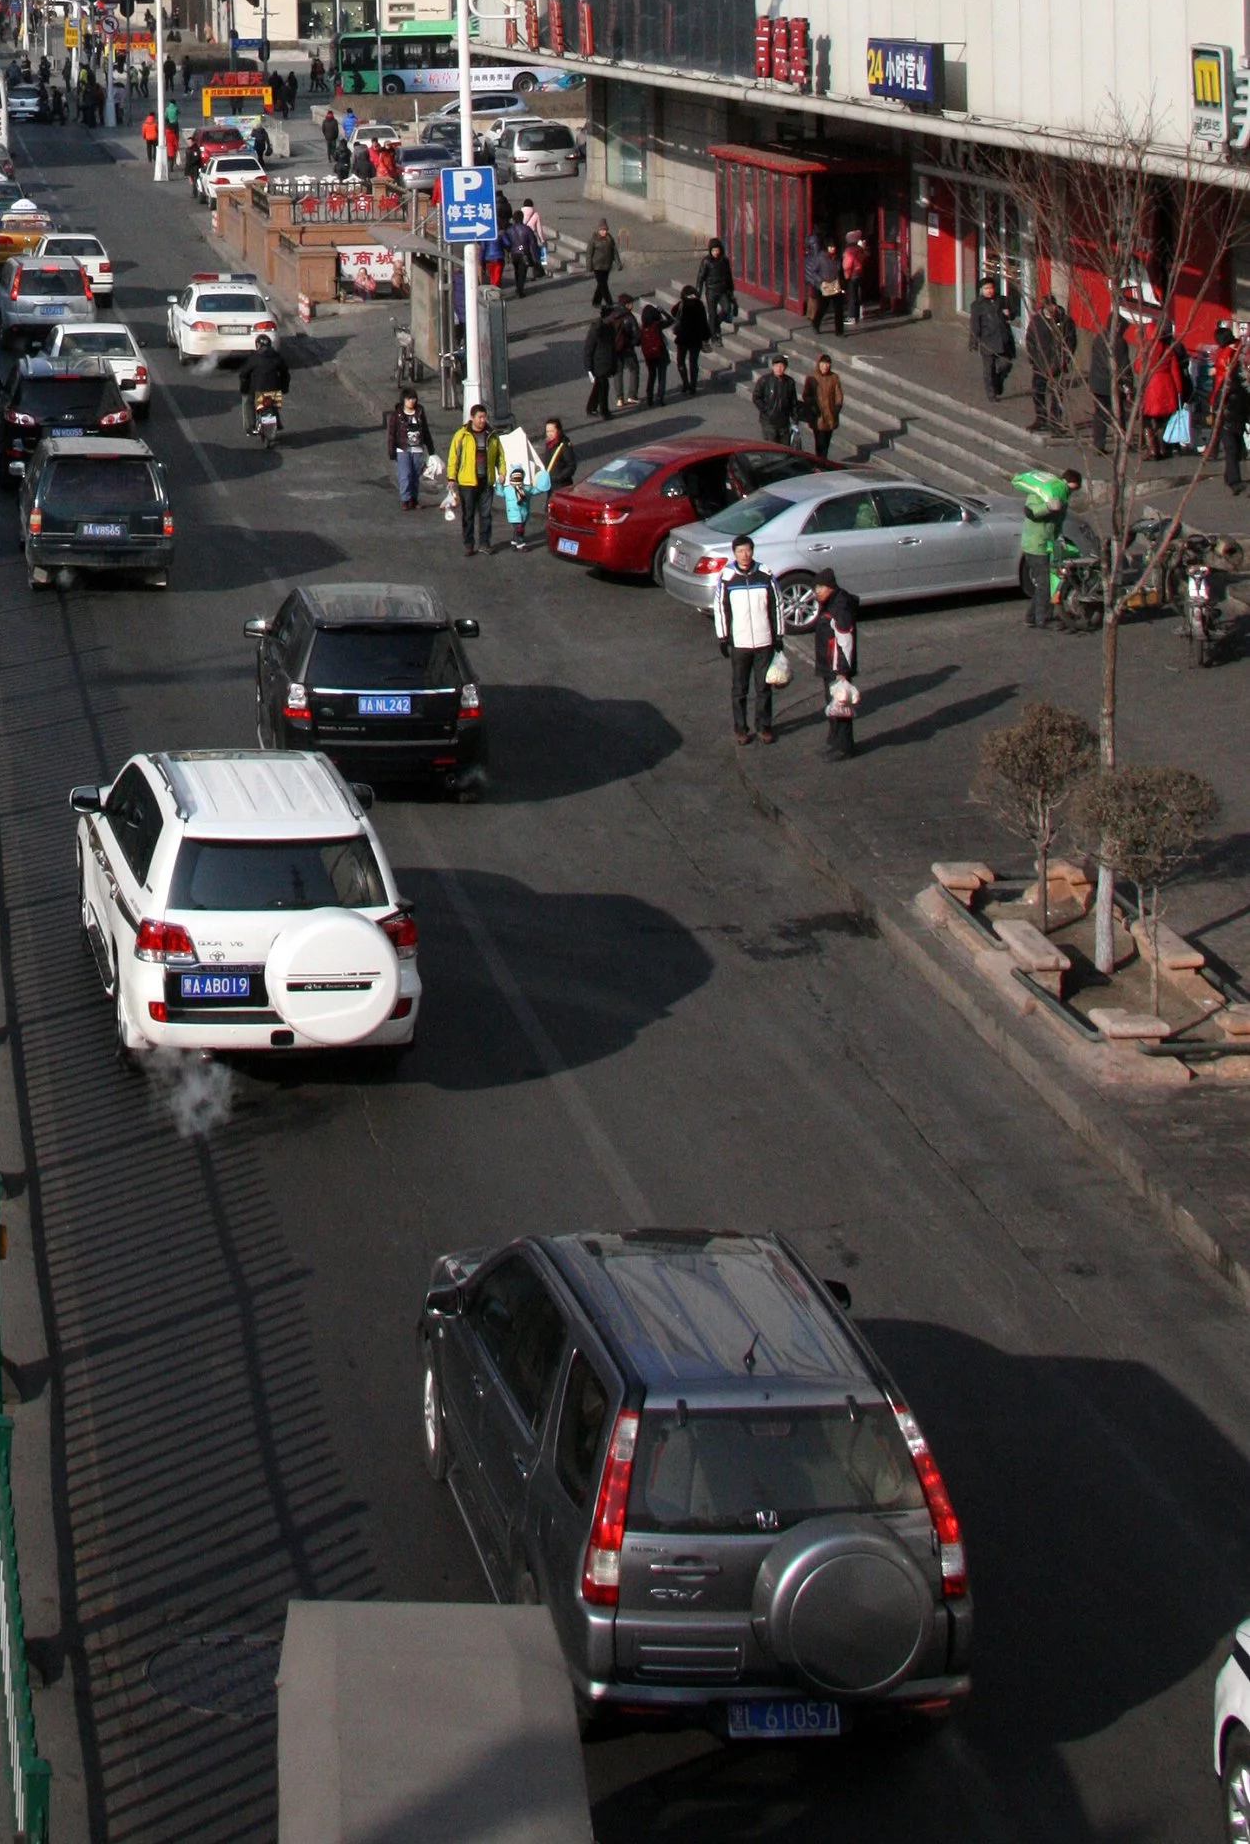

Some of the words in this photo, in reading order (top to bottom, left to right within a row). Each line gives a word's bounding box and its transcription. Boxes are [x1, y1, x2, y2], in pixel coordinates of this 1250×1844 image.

[867, 48, 883, 85] 24
[886, 51, 927, 91] 小时营业
[453, 170, 482, 201] P
[447, 203, 492, 221] 停车场
